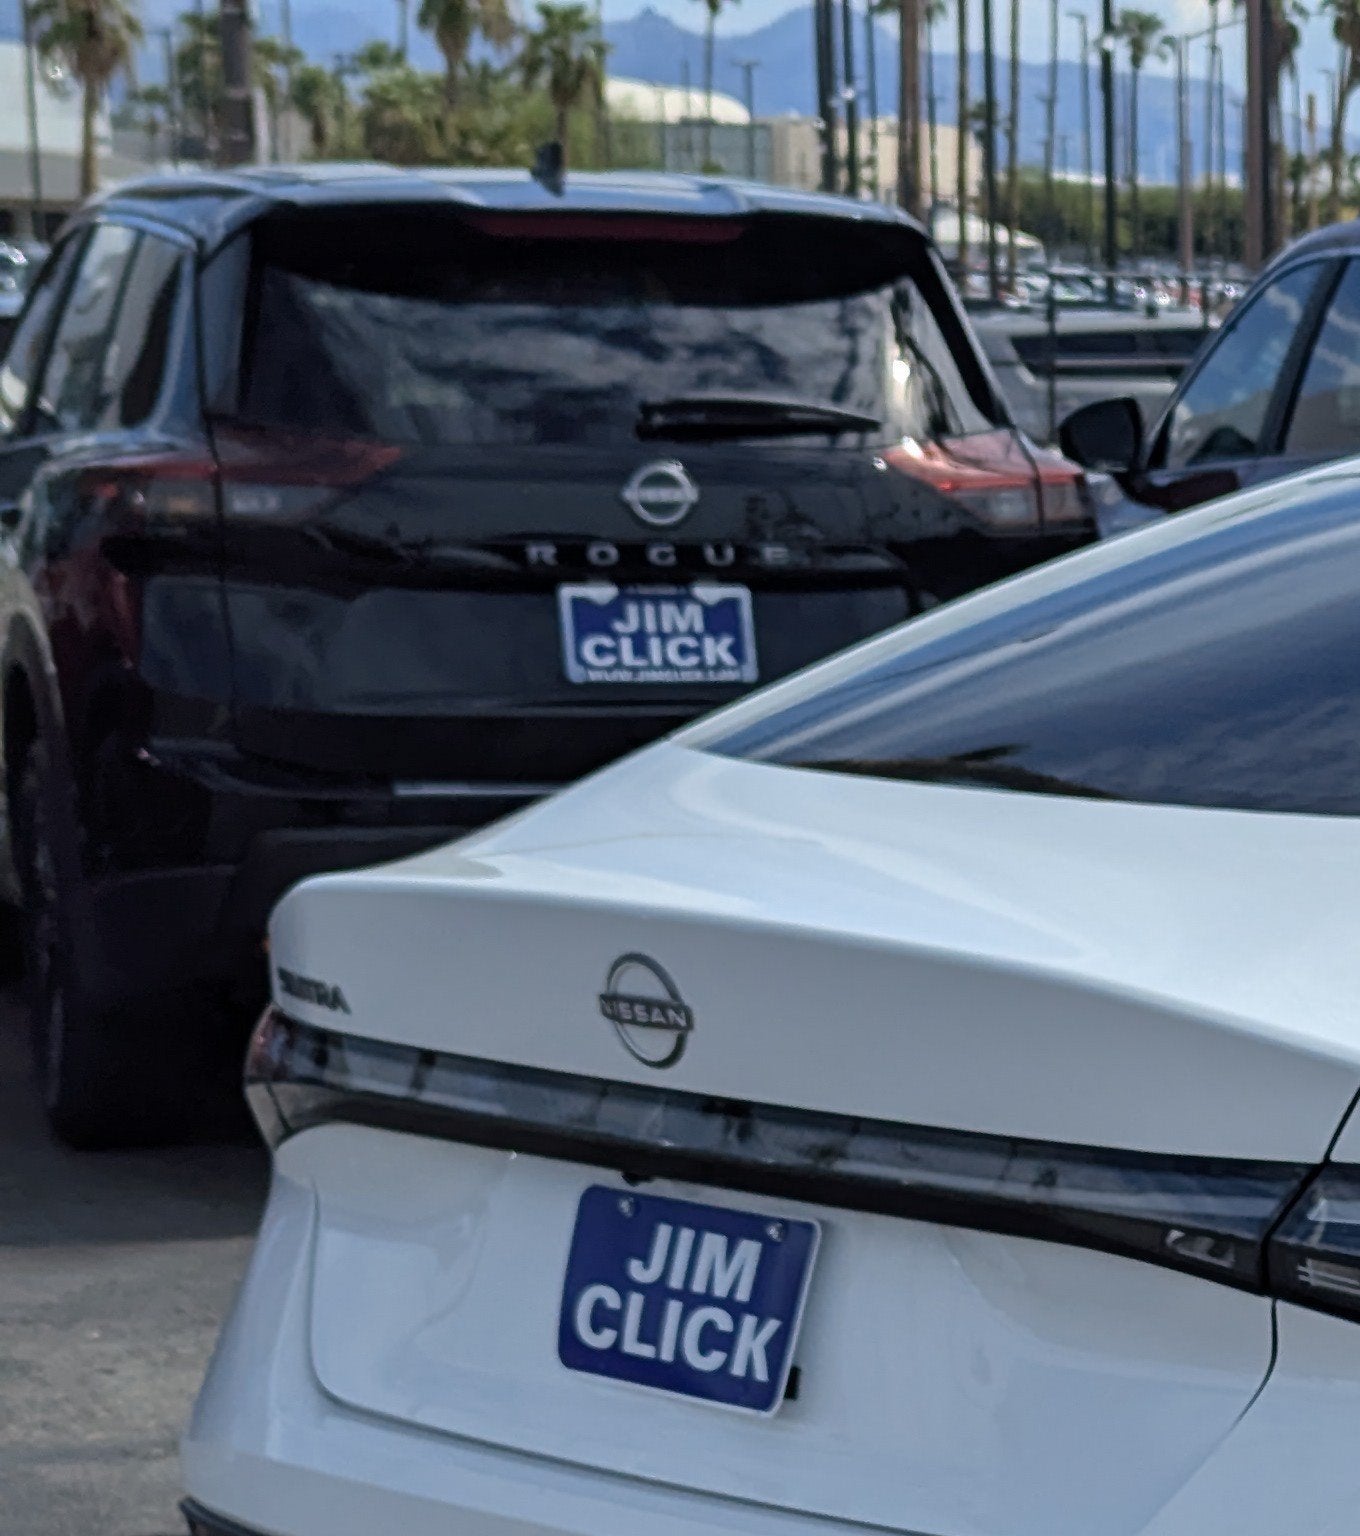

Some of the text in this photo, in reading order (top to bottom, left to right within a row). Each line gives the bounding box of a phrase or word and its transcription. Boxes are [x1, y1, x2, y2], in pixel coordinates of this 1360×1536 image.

[525, 541, 790, 567] ROGUE
[612, 601, 705, 634] JIM
[580, 634, 739, 668] CLICK
[604, 999, 688, 1028] NISSAN
[626, 1222, 762, 1302] JIM
[575, 1283, 782, 1383] CLICK
